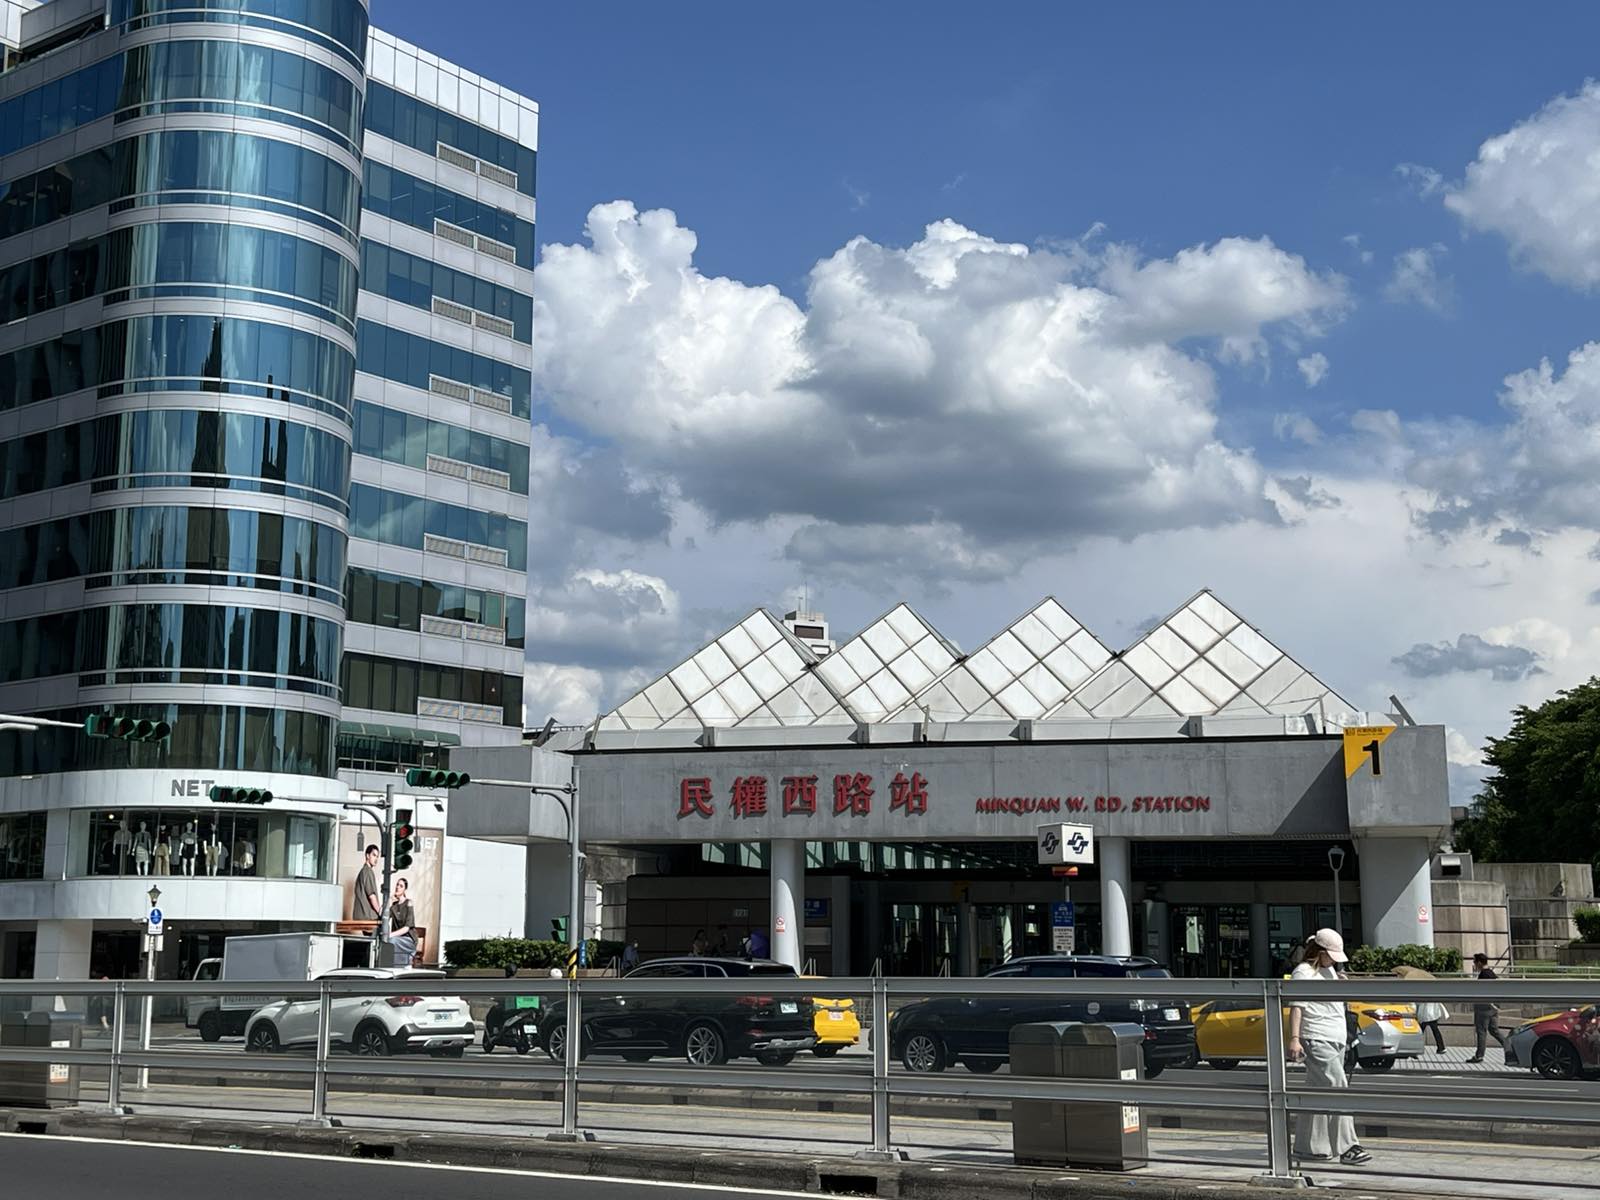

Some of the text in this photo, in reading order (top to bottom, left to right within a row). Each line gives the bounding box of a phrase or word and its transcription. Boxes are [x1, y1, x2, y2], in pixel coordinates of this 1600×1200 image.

[1362, 739, 1381, 775] 1
[171, 779, 215, 797] NET
[677, 771, 929, 820] 民權西路站
[975, 796, 1211, 816] MINQUAN W. RD. STATION
